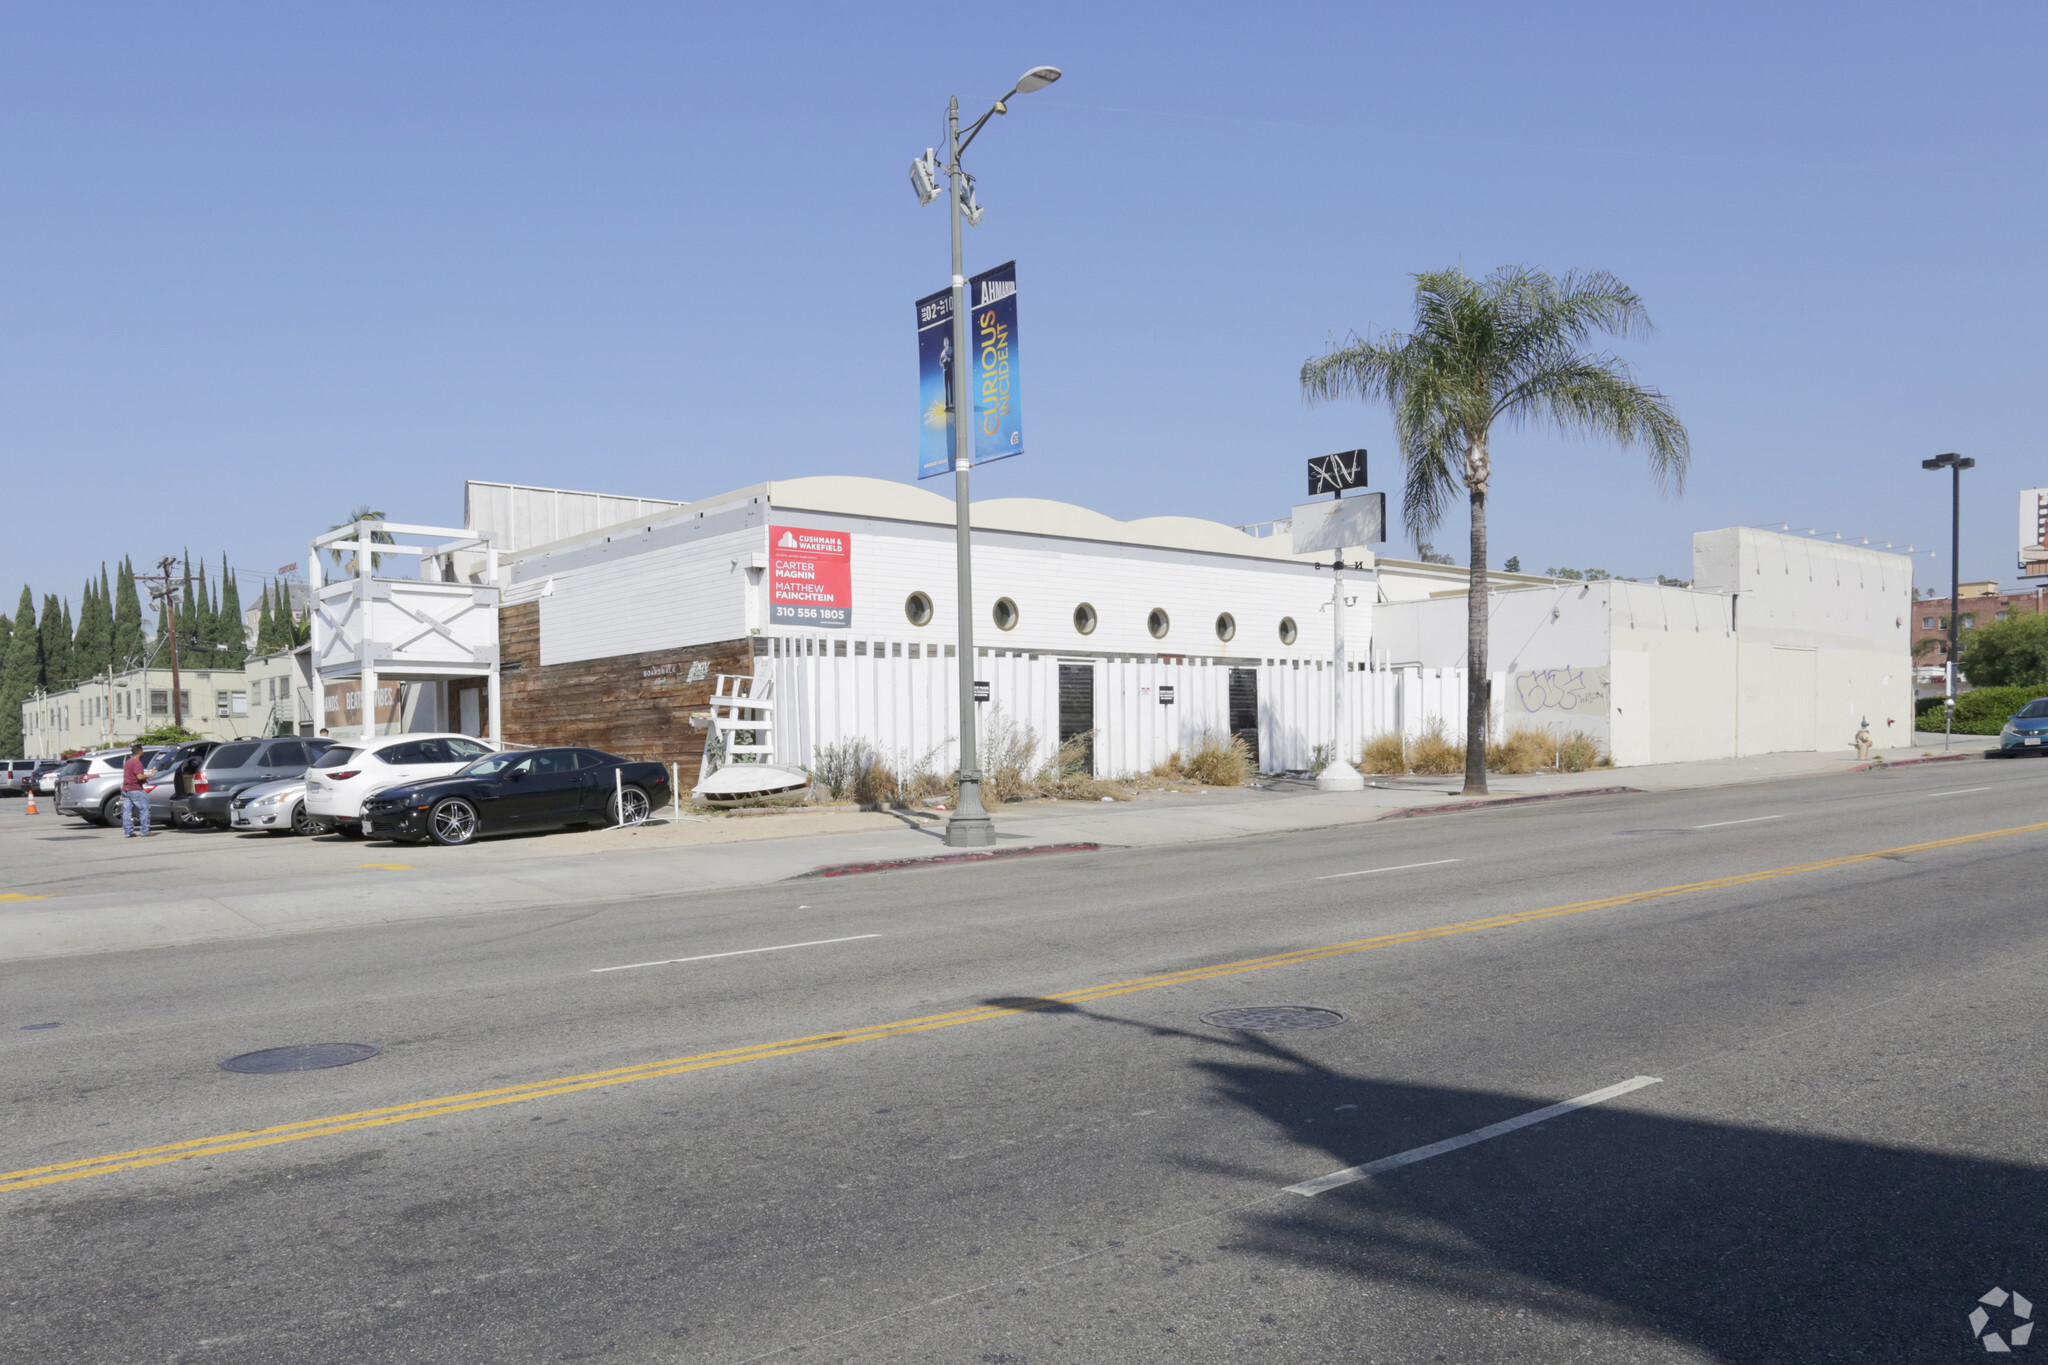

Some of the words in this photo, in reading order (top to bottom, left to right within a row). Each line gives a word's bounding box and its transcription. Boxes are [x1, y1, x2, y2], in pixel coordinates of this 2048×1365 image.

[926, 303, 937, 320] 02
[980, 309, 999, 436] CURIOUS
[996, 323, 1011, 416] INCIDENT
[799, 535, 836, 544] CUSHMAN
[799, 542, 843, 552] WAKEFIELD
[775, 560, 815, 571] CARTER
[775, 569, 815, 580] MAGNIN
[775, 582, 825, 593] MATTHEW
[775, 591, 835, 602] FAINCHTEIN
[776, 607, 795, 617] 310
[797, 608, 818, 618] 556
[820, 609, 845, 619] 1805
